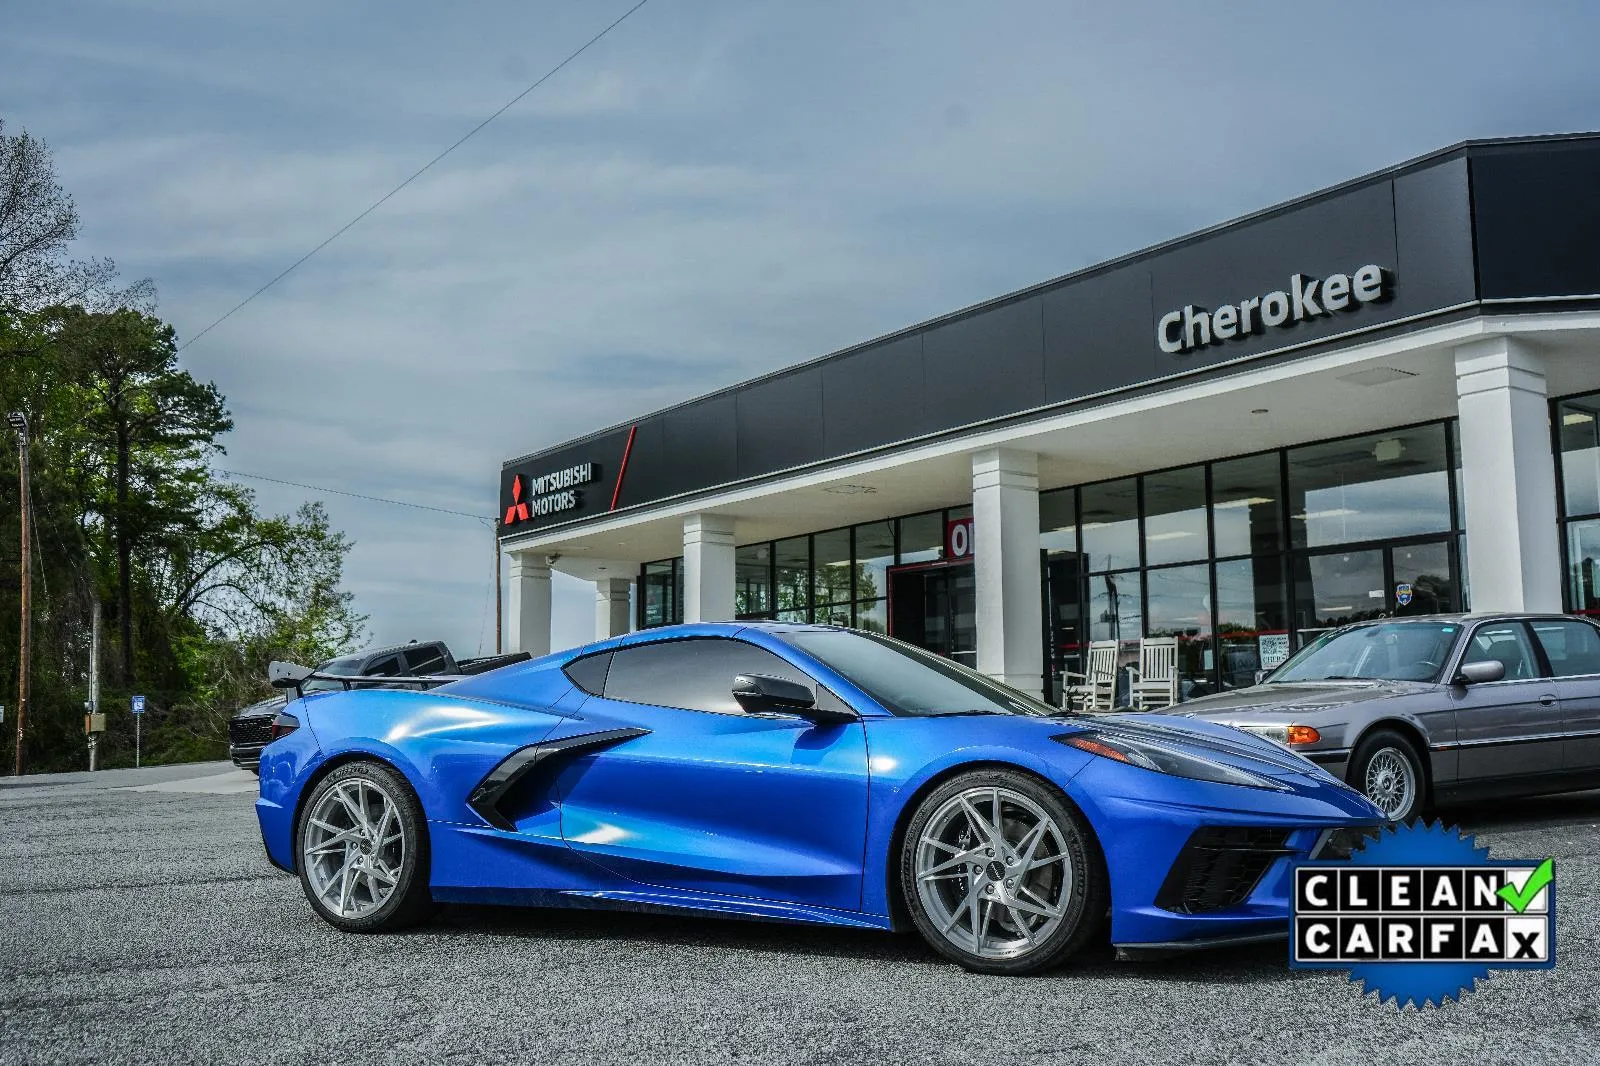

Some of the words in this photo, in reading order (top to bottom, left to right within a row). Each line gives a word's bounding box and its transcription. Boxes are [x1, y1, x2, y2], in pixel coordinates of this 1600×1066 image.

[1158, 264, 1382, 353] Cherokee
[532, 462, 592, 496] MITSUBISHI
[532, 490, 576, 517] MOTORS
